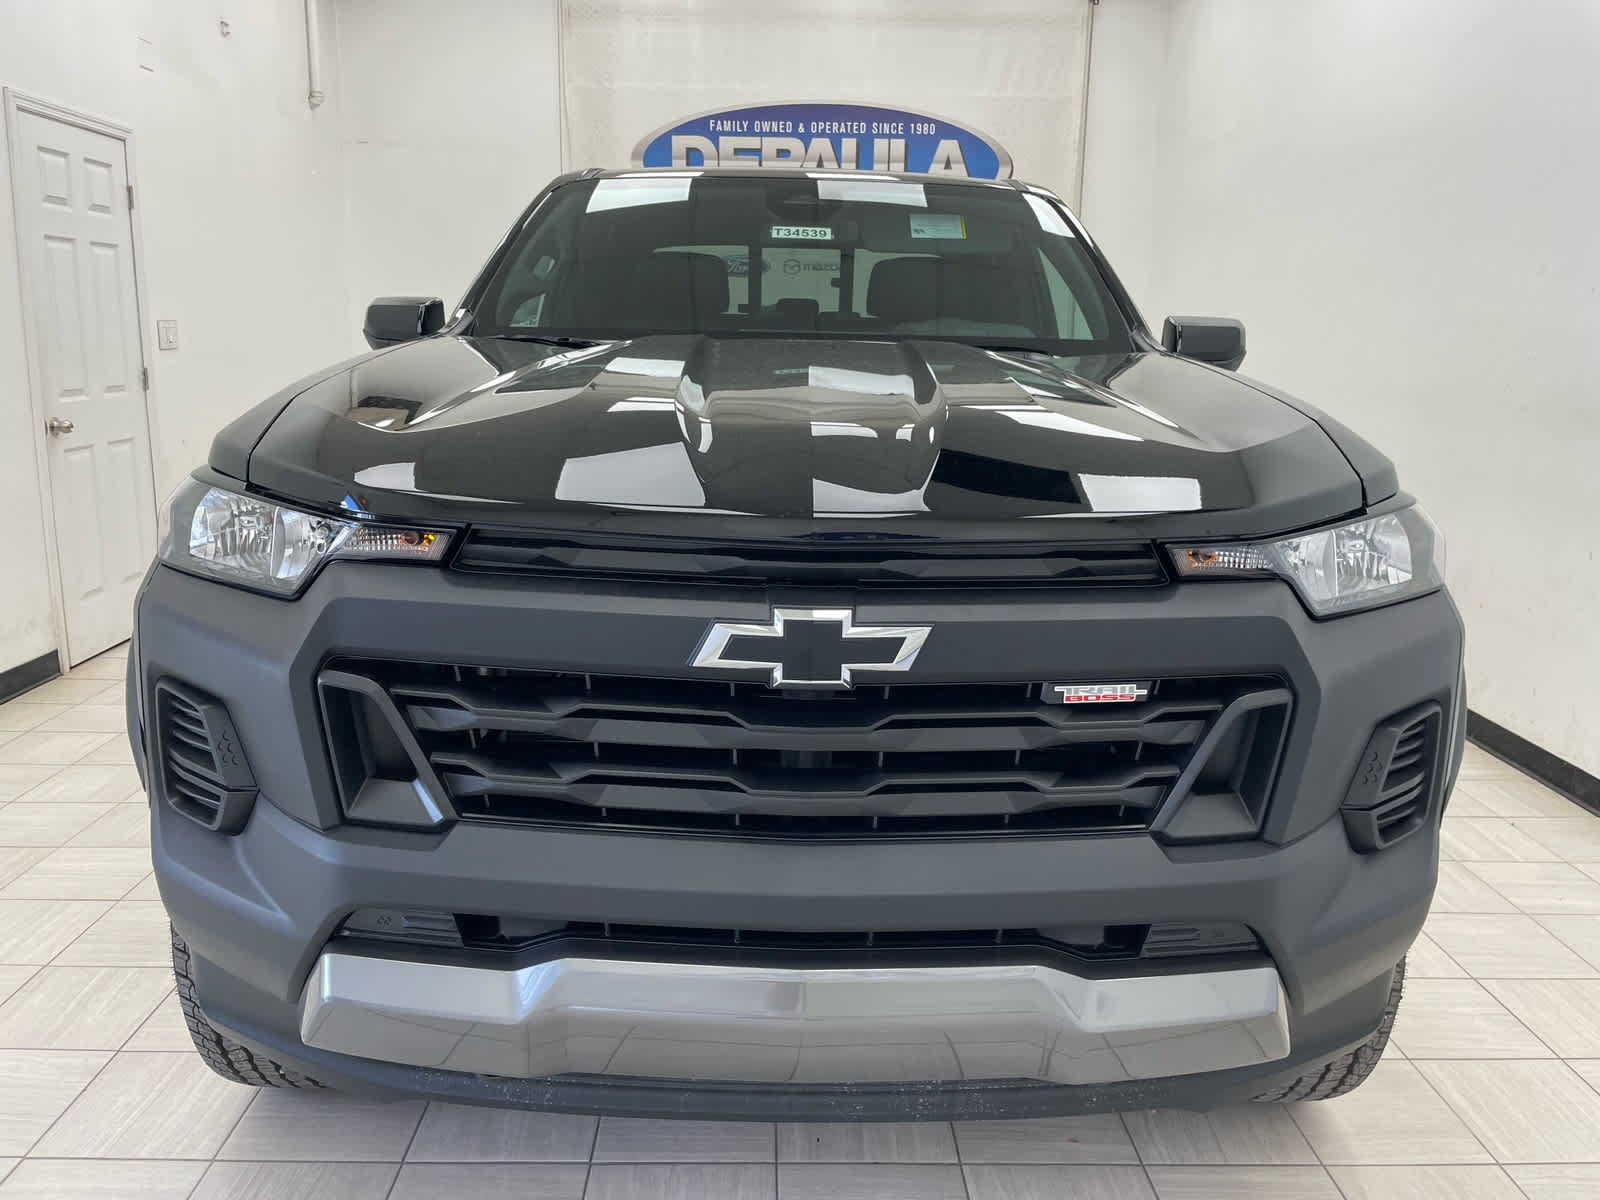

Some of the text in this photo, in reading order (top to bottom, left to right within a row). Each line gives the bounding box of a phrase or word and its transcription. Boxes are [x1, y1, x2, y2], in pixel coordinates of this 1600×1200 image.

[709, 119, 936, 135] FAMILY OWNED & OPERATED SINCE 1980
[774, 228, 827, 238] T34539
[801, 263, 840, 272] mazd
[1054, 684, 1147, 696] TRAIL
[1064, 694, 1136, 703] BOSS
